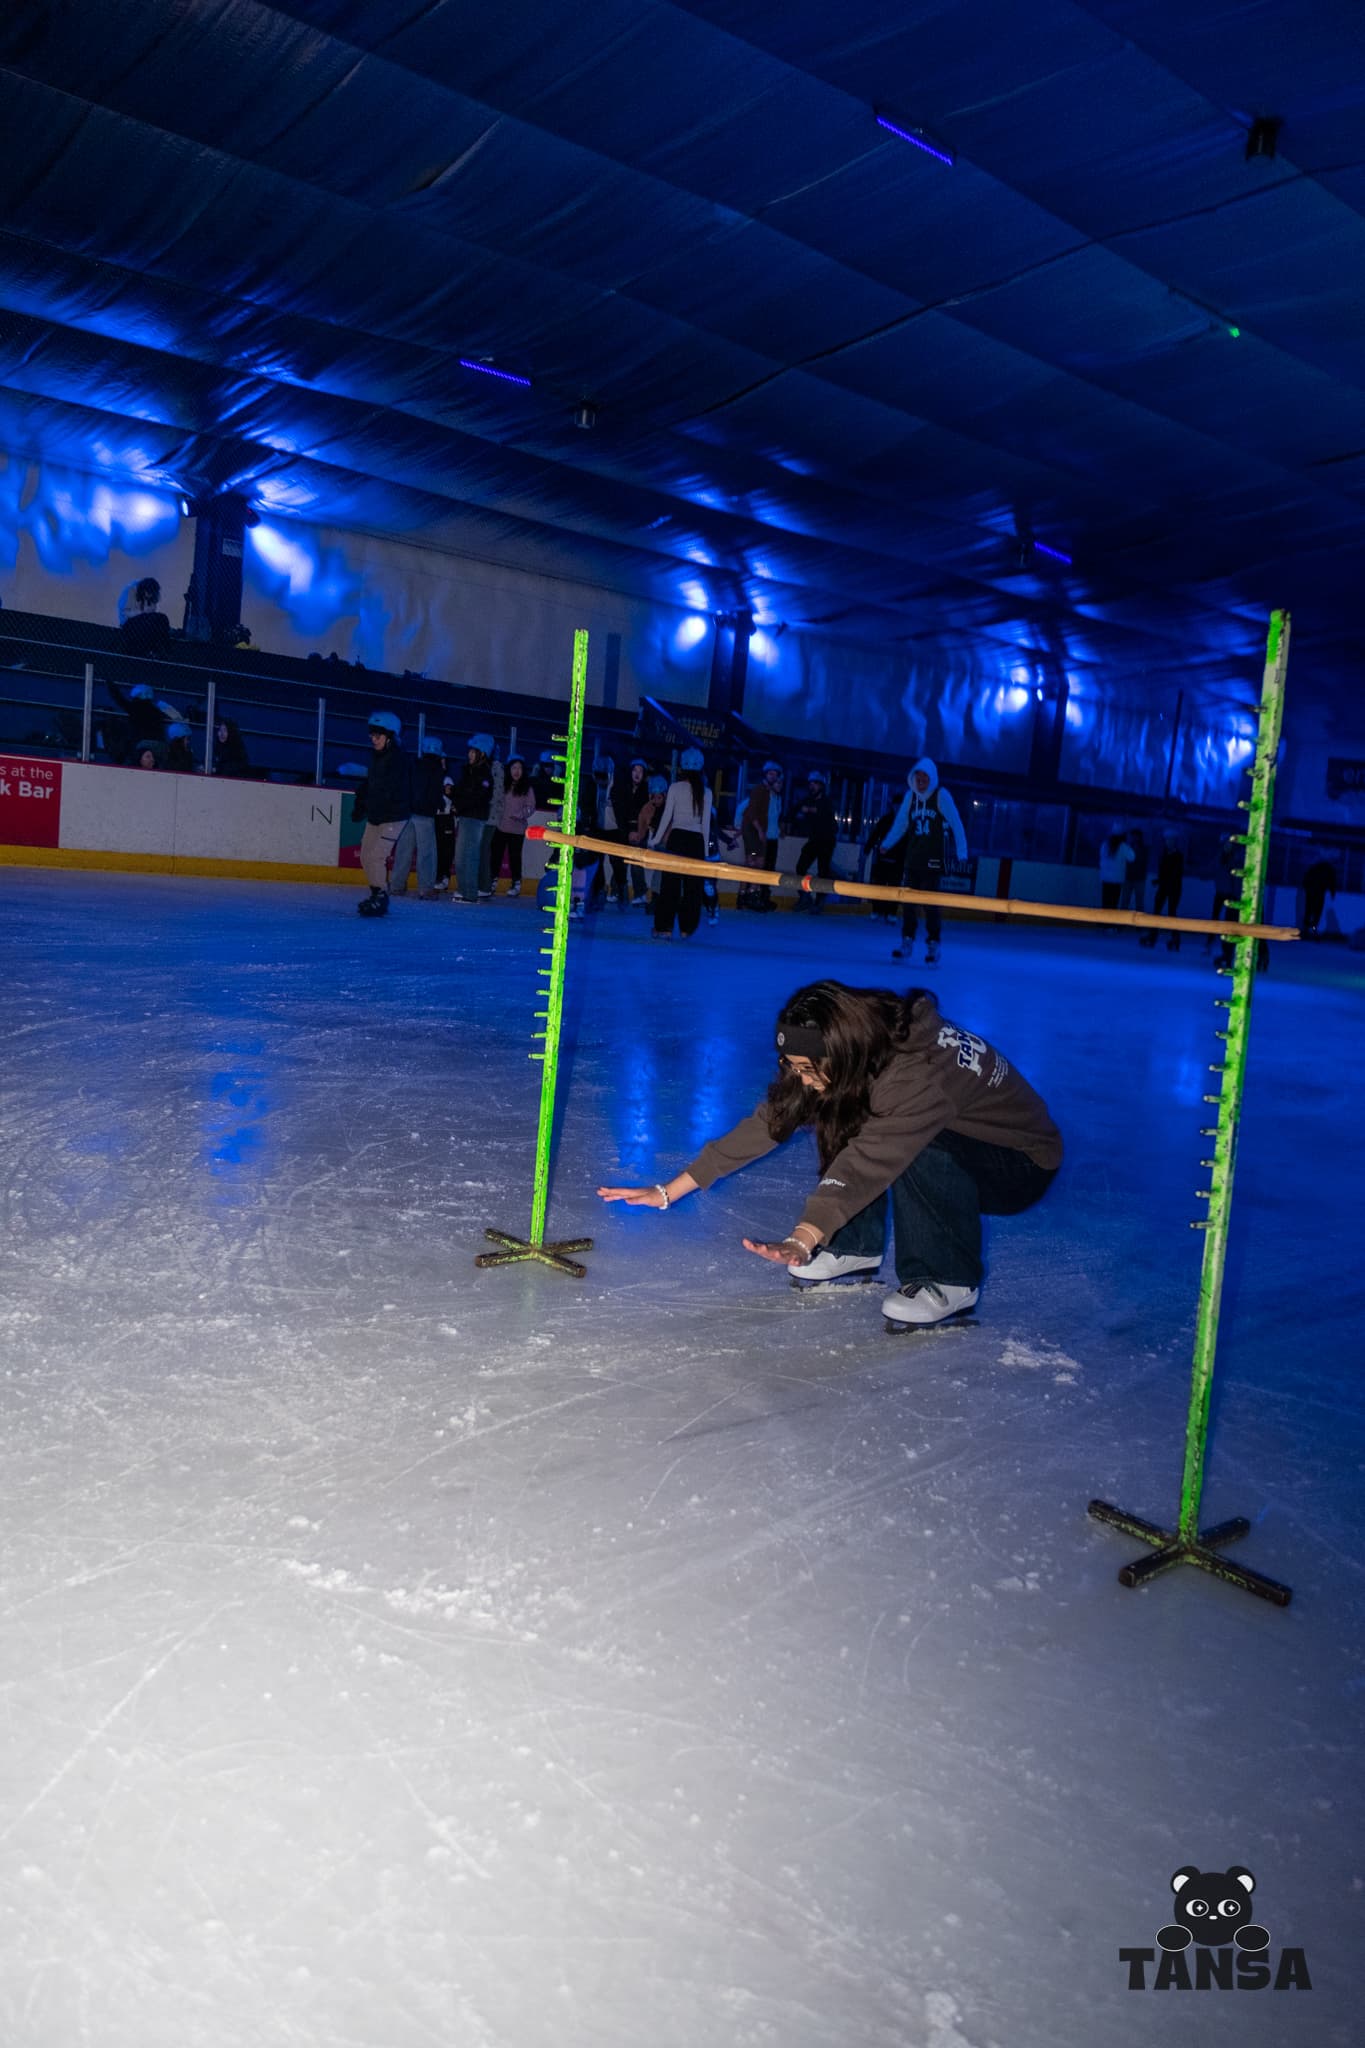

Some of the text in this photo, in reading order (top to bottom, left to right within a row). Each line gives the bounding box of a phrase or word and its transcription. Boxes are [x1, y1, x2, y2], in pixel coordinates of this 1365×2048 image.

[11, 765, 25, 778] at
[30, 766, 54, 780] the
[18, 780, 54, 800] Bar
